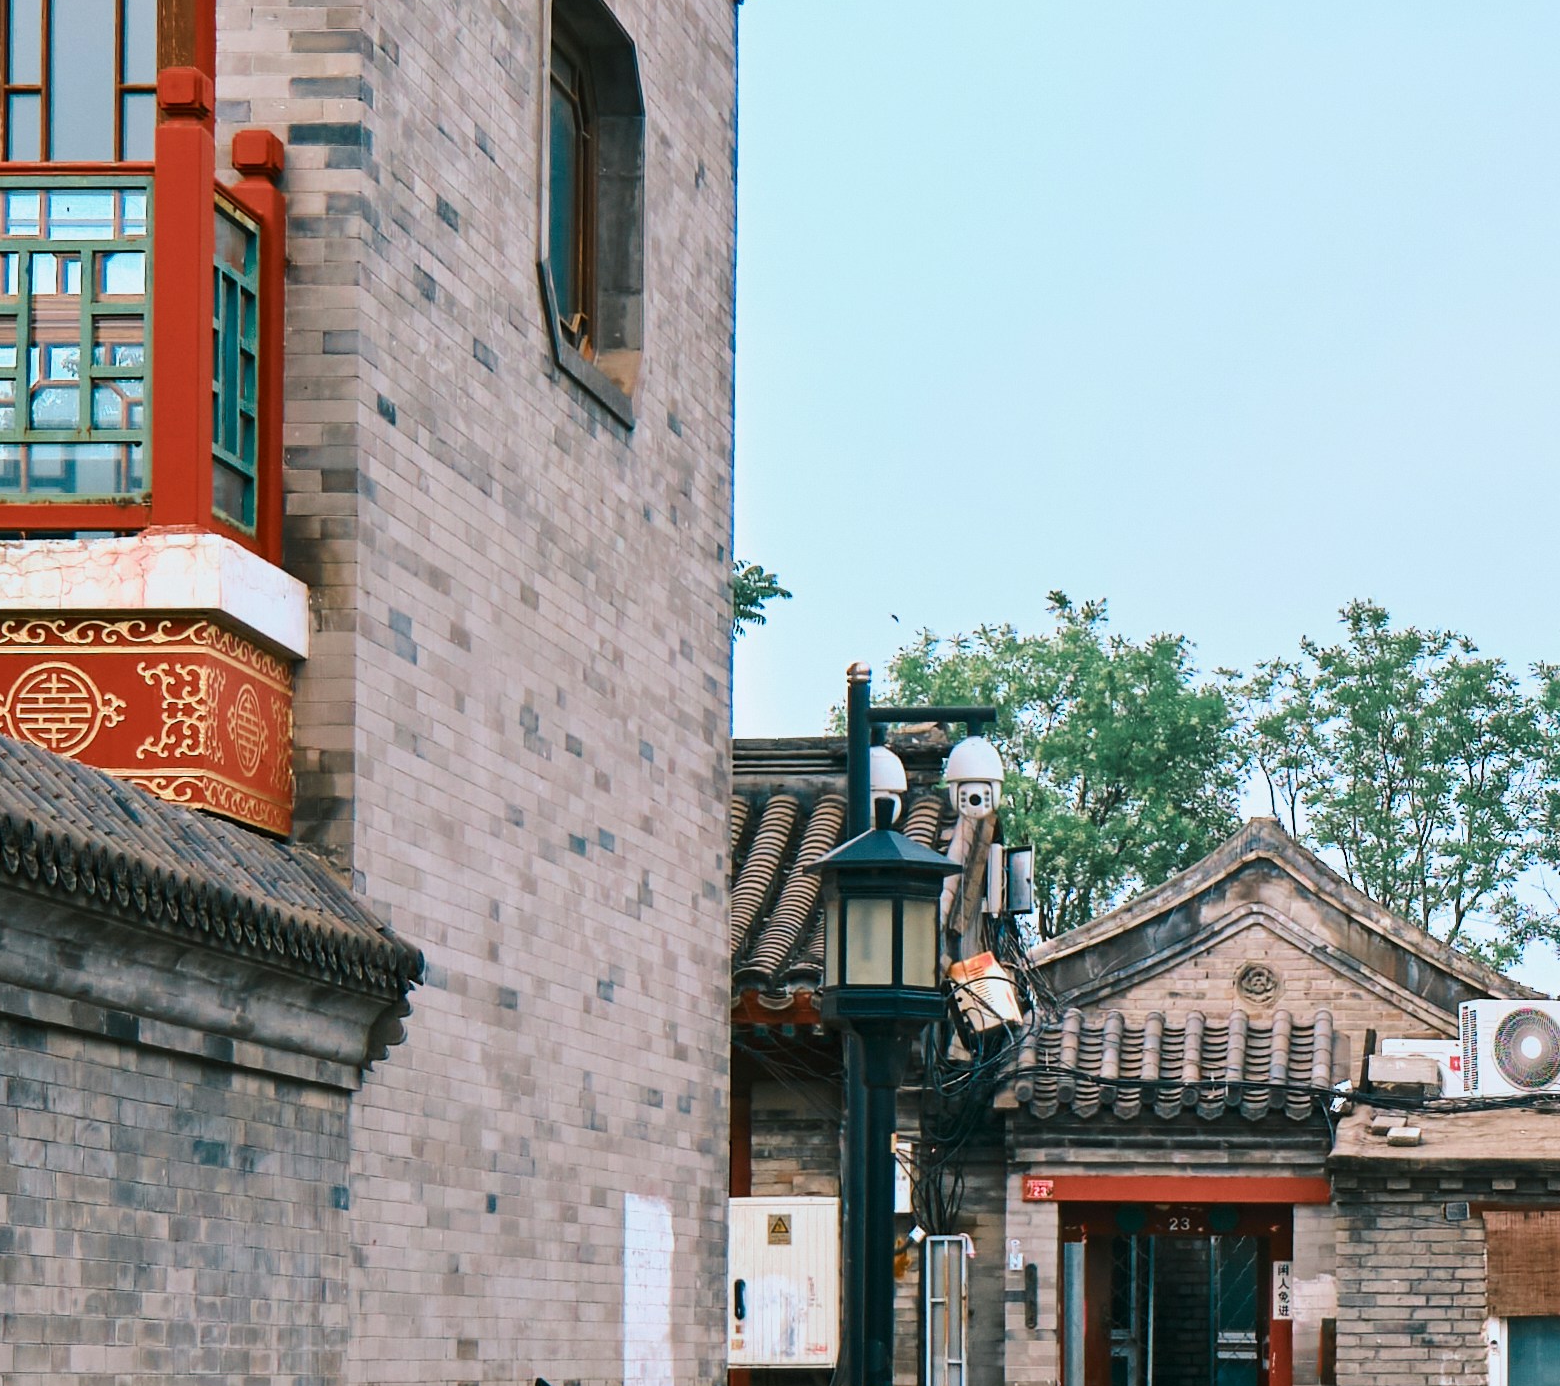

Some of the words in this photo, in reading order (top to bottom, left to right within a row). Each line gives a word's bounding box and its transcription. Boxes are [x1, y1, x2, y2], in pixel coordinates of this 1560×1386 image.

[1034, 1187, 1047, 1198] 23
[1169, 1217, 1190, 1231] 23
[1278, 1264, 1290, 1317] 闲人免进
